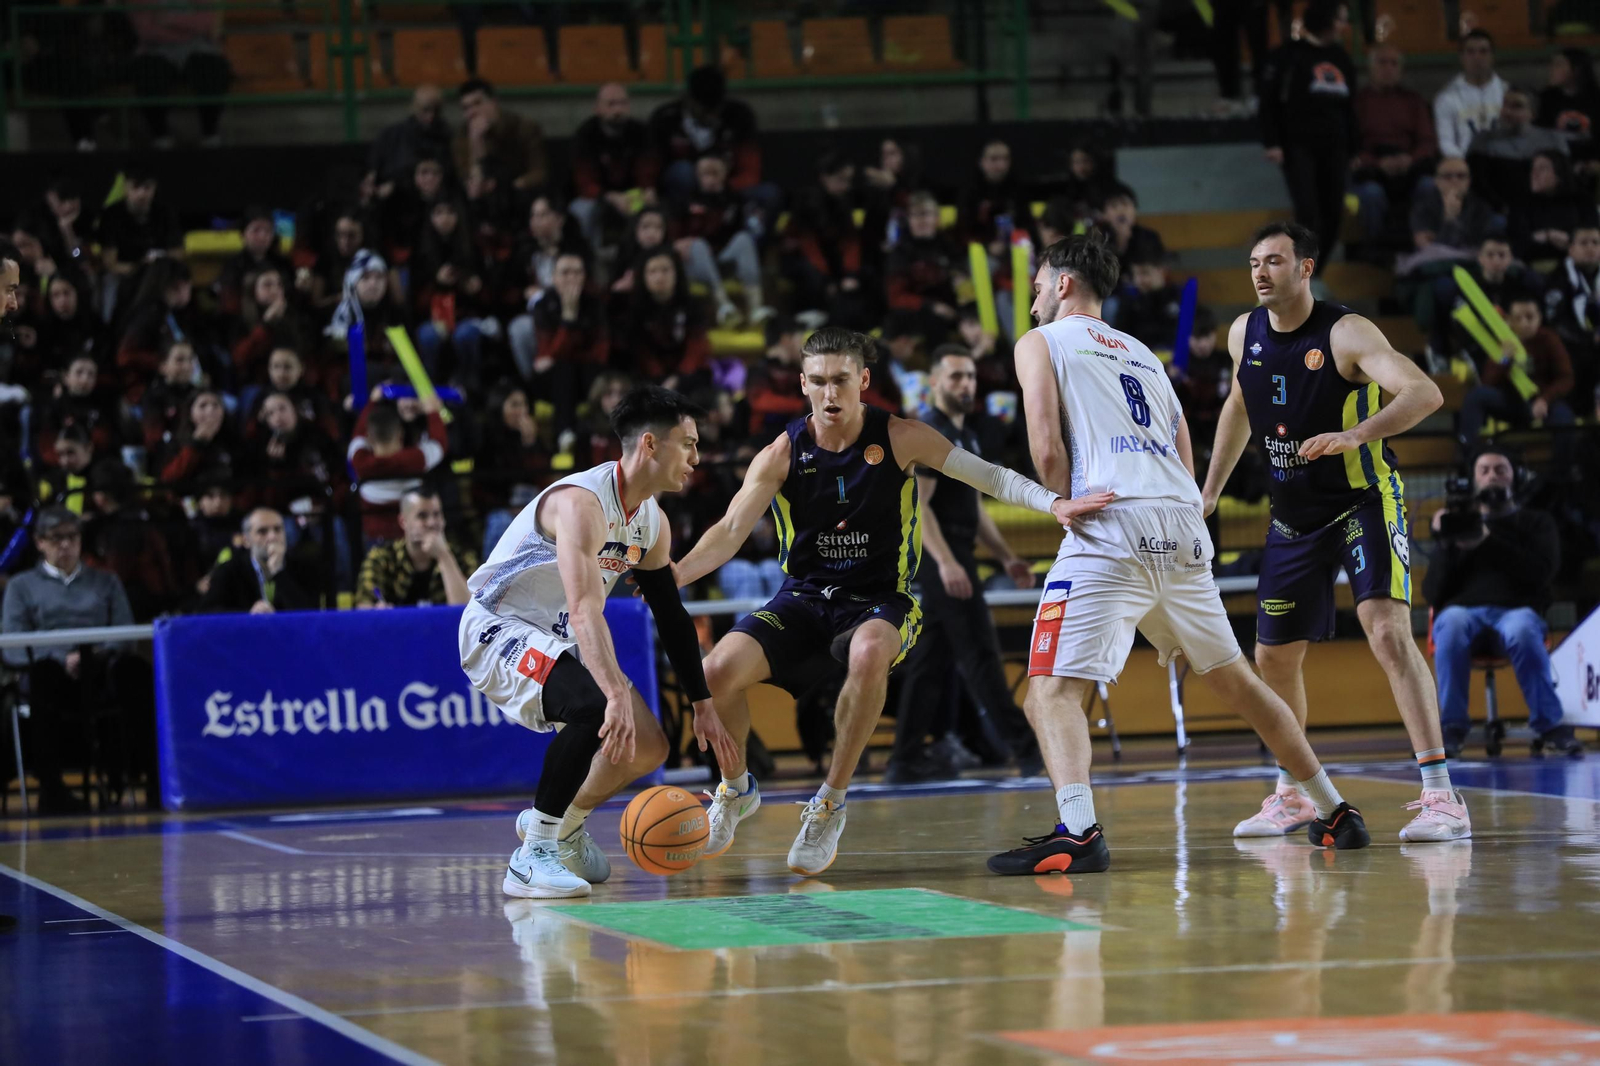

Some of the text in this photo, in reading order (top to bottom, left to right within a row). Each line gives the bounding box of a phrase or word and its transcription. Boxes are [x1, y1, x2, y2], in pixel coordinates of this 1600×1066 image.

[1120, 373, 1151, 428] 8
[1272, 374, 1287, 405] 3
[1265, 436, 1300, 454] Estrell
[836, 476, 849, 504] 1
[816, 532, 869, 546] Estrella
[818, 545, 868, 559] Galicia
[1352, 544, 1366, 575] 3
[202, 682, 516, 738] Estrella Gali
